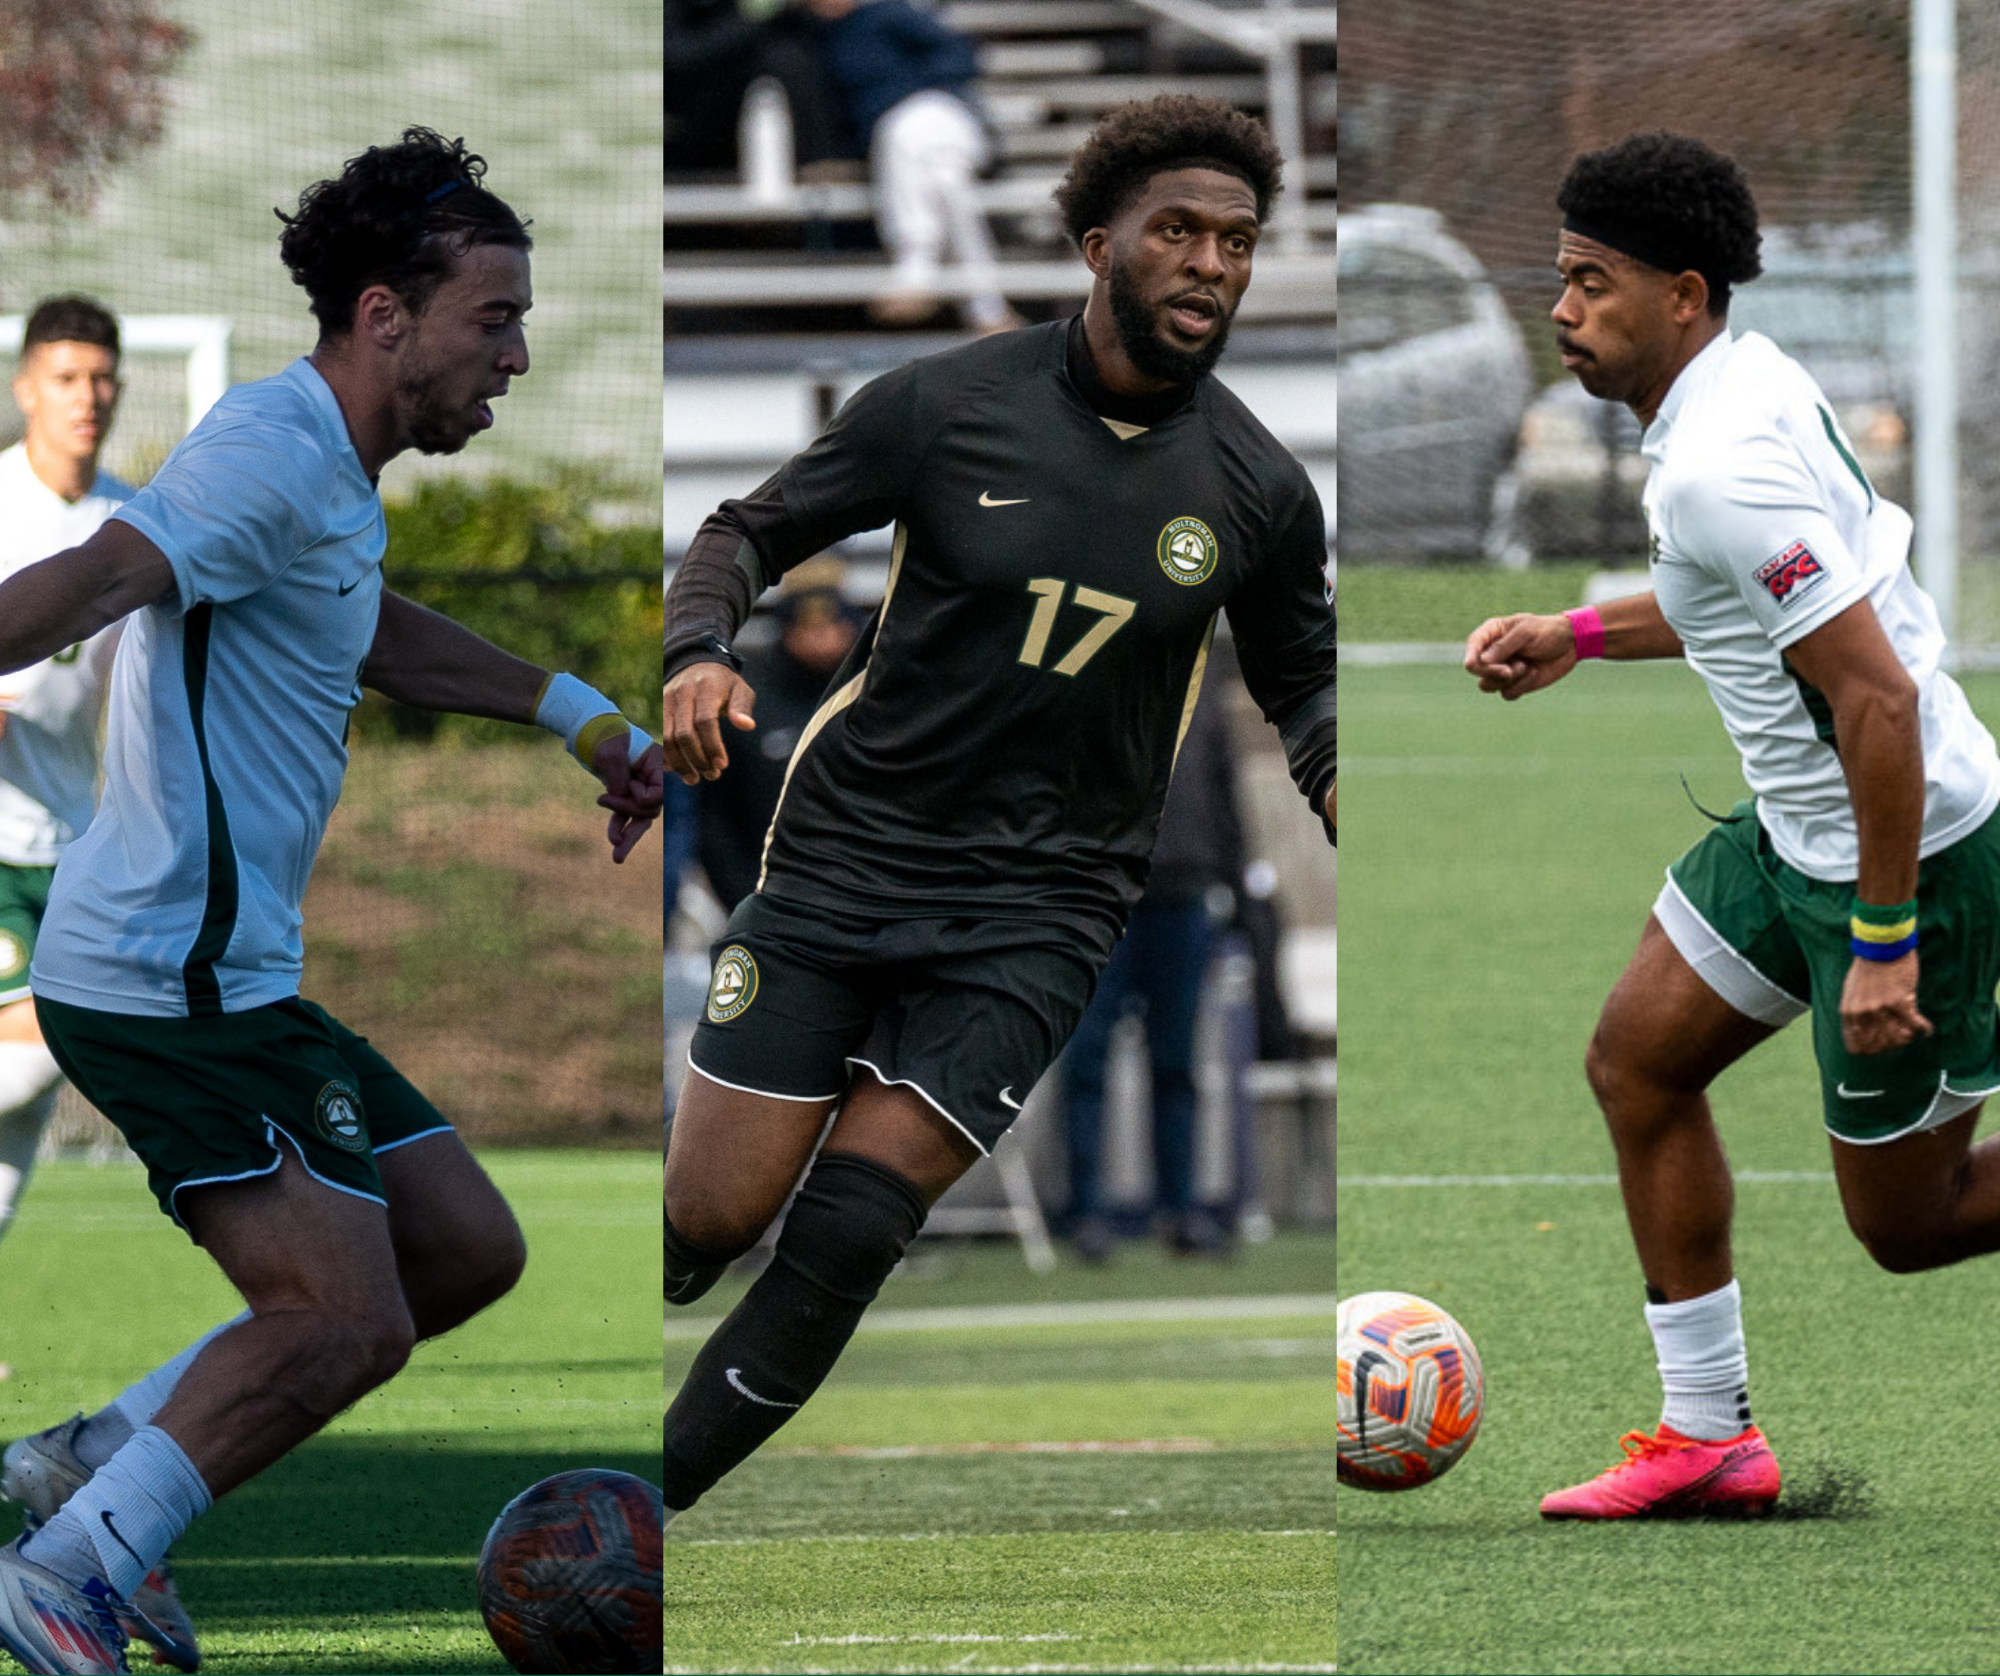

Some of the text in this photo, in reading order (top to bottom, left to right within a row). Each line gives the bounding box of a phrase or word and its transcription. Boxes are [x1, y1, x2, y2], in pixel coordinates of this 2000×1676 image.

[1168, 519, 1215, 548] MULTNOMAH
[1163, 559, 1205, 582] UNIVERSITY
[1768, 553, 1818, 597] CCC
[1018, 577, 1138, 677] 17
